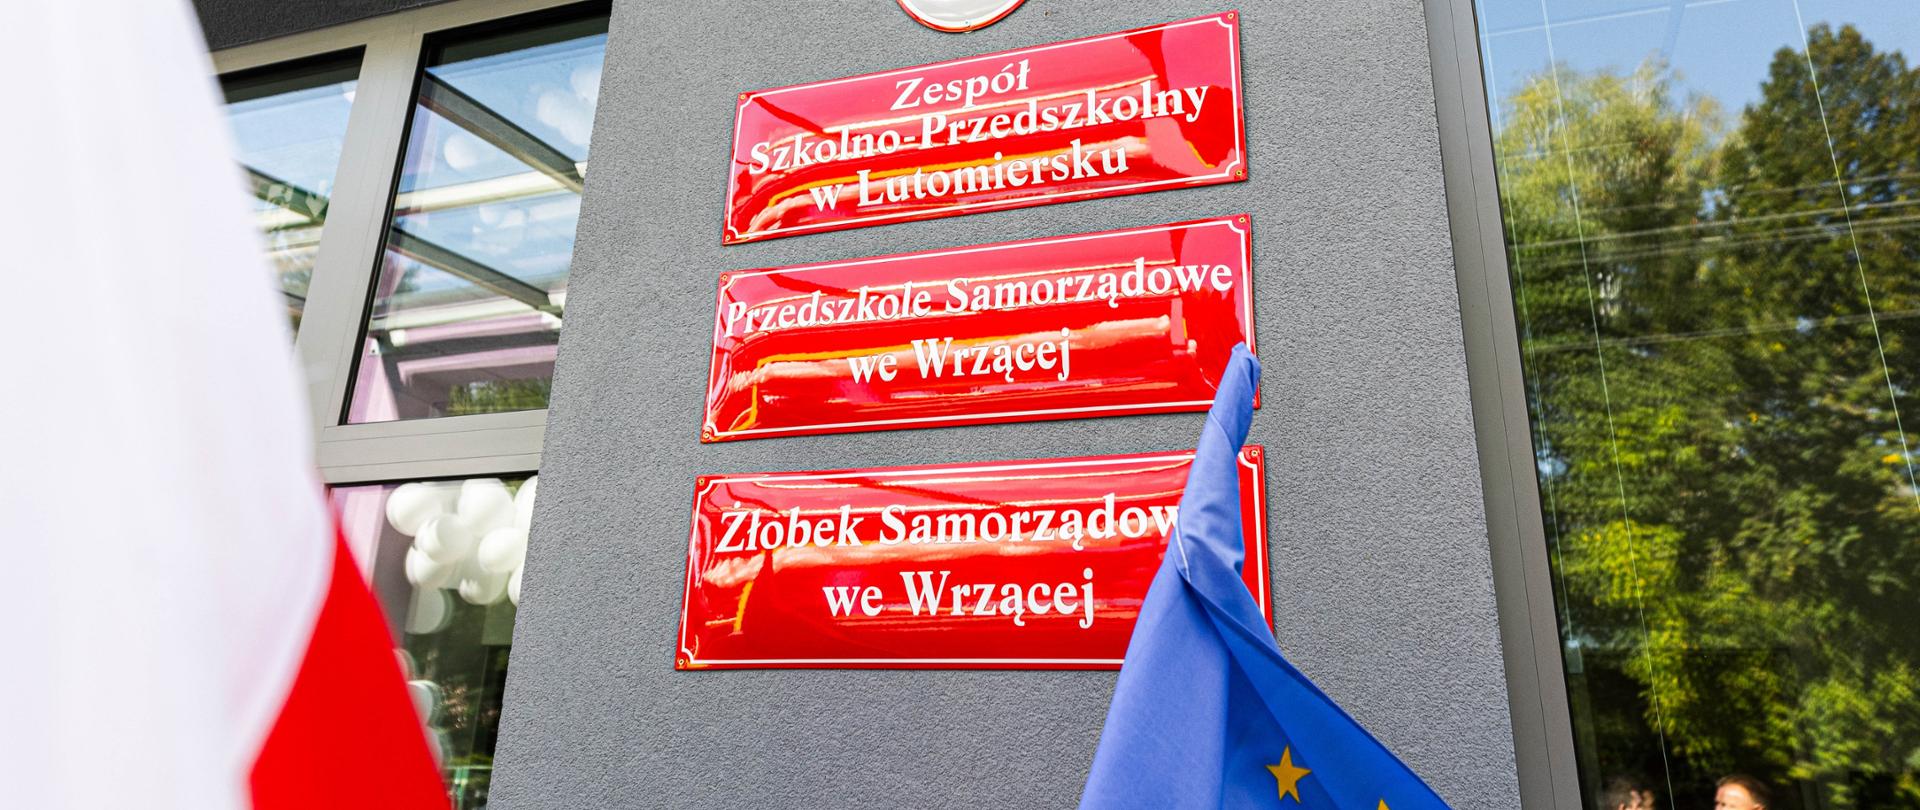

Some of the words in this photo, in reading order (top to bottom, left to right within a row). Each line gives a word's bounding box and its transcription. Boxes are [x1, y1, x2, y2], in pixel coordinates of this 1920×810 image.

[890, 60, 1031, 111] Zespół
[748, 83, 1209, 176] Szkolno-Przedszkolny
[810, 183, 841, 212] w
[856, 142, 1128, 207] Lutomiersku
[725, 281, 932, 338] Przedszkole
[945, 257, 1233, 314] Samorządowe
[848, 353, 898, 384] we
[910, 328, 1071, 381] Wrzącej
[714, 501, 864, 553] Żłobek
[880, 493, 1180, 551] Samorządow
[823, 582, 884, 616] we
[900, 567, 1095, 629] Wrzącej
